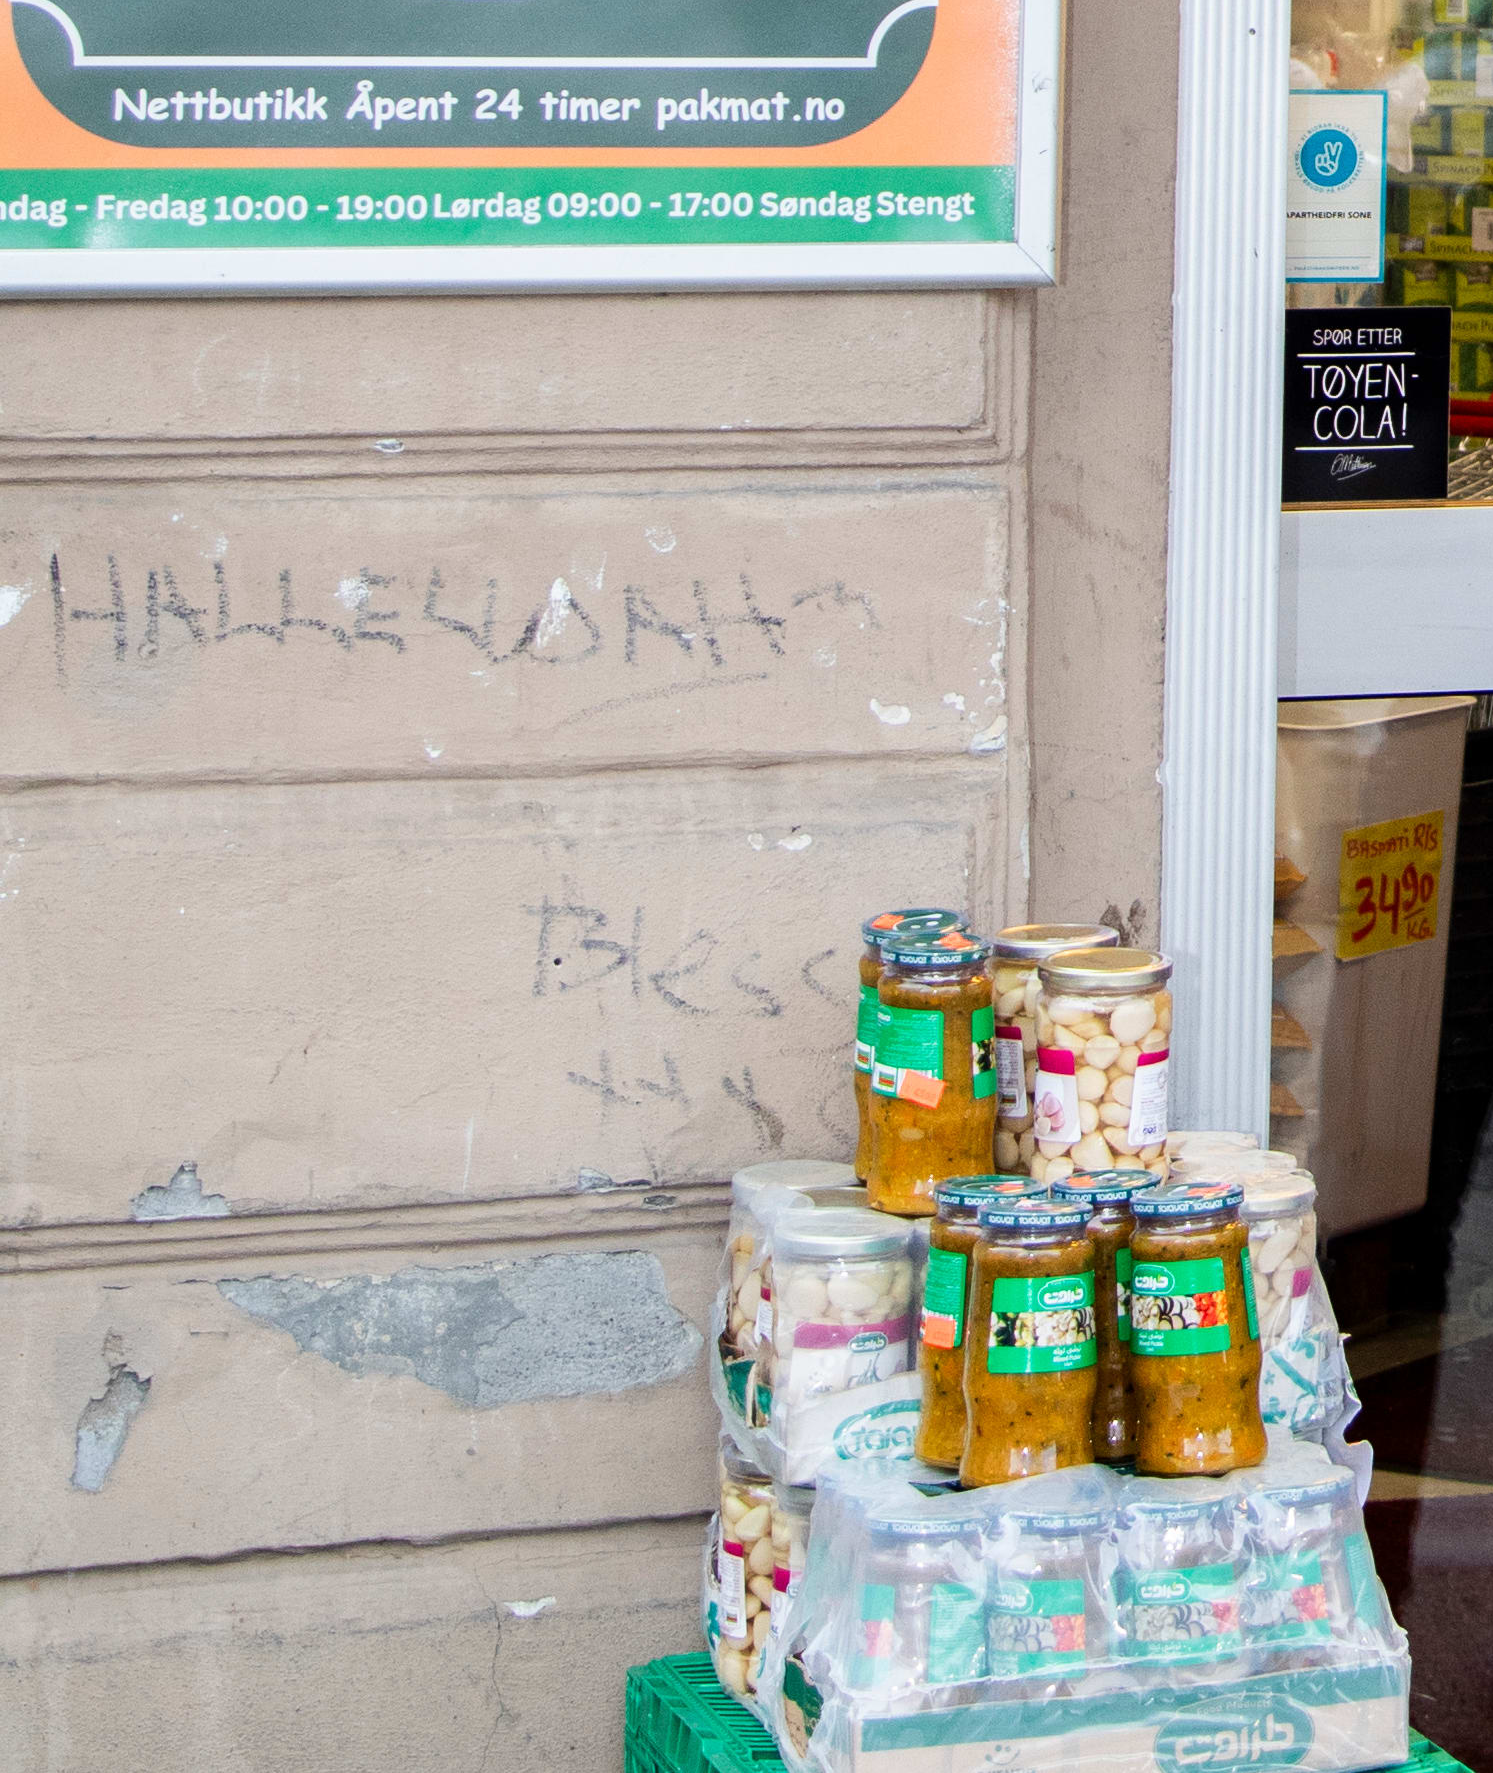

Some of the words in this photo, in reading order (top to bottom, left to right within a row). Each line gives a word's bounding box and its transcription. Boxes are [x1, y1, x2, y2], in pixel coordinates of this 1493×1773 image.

[113, 85, 328, 123] Nettbutikk
[346, 80, 457, 131] Åpent
[474, 87, 522, 122] 24
[541, 89, 641, 123] timer
[656, 90, 845, 130] pakmat.no
[96, 193, 207, 231] Fredag
[213, 194, 308, 222] 10:00
[335, 194, 428, 222] 19:00
[433, 192, 542, 227] Lørdag
[547, 192, 641, 221] 09:00
[668, 191, 754, 220] 17:00
[759, 190, 871, 227] Søndag
[876, 188, 976, 224] Stengt
[1312, 329, 1352, 346] SPØR
[1357, 328, 1402, 346] ETTER
[1314, 403, 1407, 441] COLA!
[1174, 1713, 1296, 1766] طراوت
